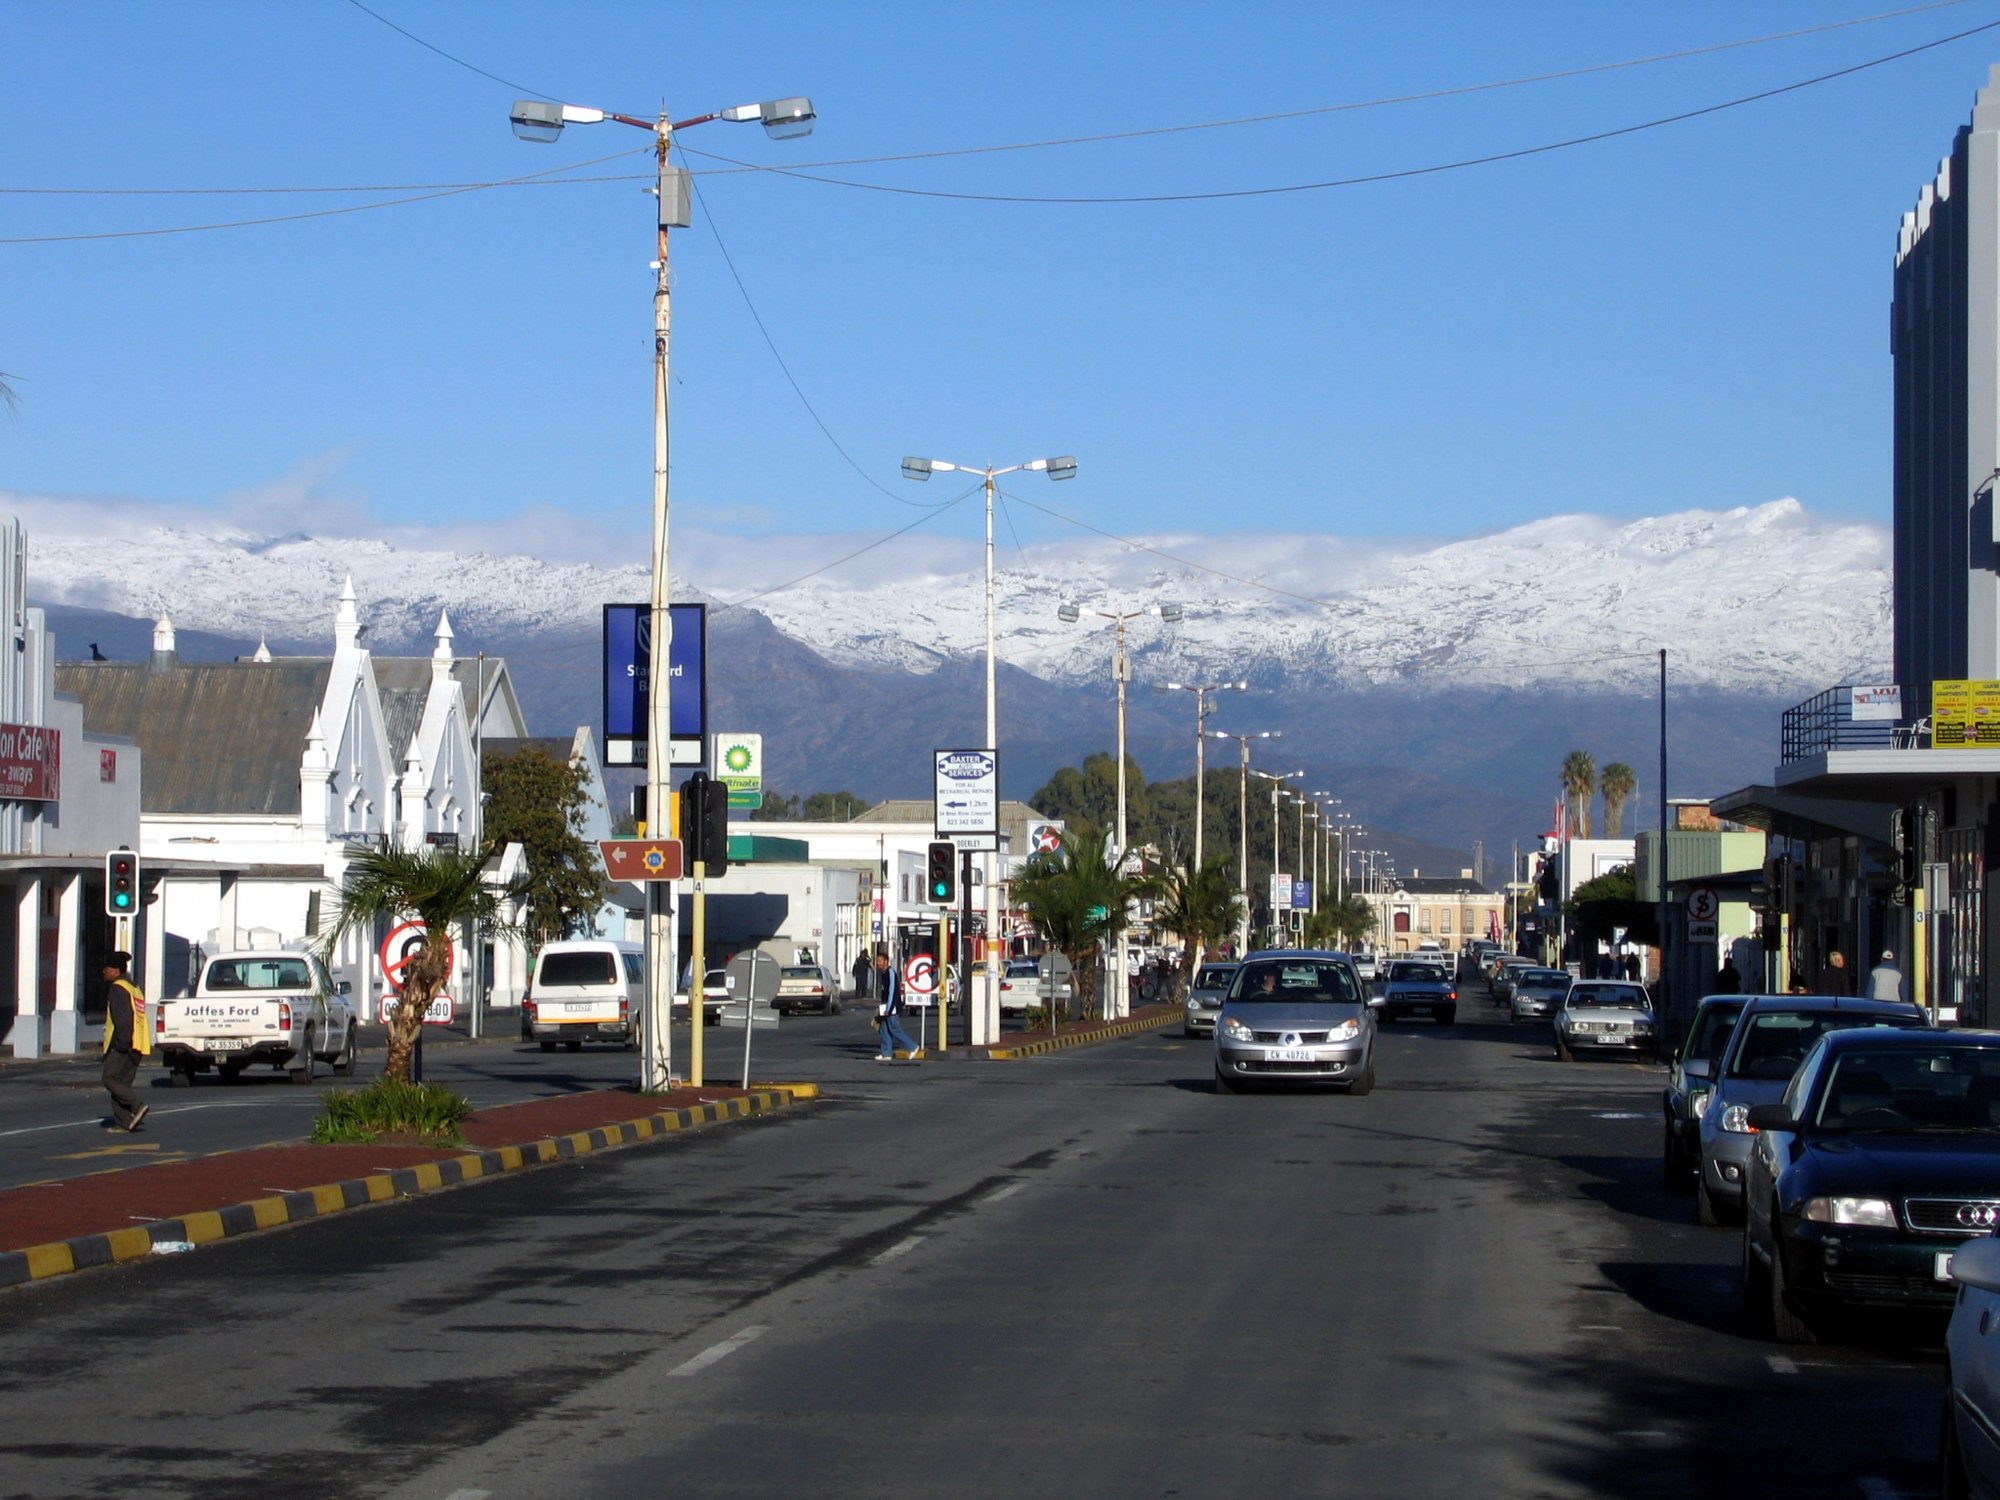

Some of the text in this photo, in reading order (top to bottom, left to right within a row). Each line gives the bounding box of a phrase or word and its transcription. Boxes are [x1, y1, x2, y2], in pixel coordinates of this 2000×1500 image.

[627, 664, 683, 677] Stard
[0, 727, 42, 761] on Cafe
[950, 755, 980, 763] BAXTER
[7, 766, 34, 787] aways
[948, 769, 983, 777] SERVICES
[956, 840, 980, 848] DDERLEY
[695, 882, 701, 892] 4
[1916, 911, 1924, 923] 3
[1616, 928, 1625, 938] P
[184, 1006, 259, 1016] Jaffes Ford
[218, 1041, 241, 1049] 35359
[1270, 1051, 1280, 1059] CW
